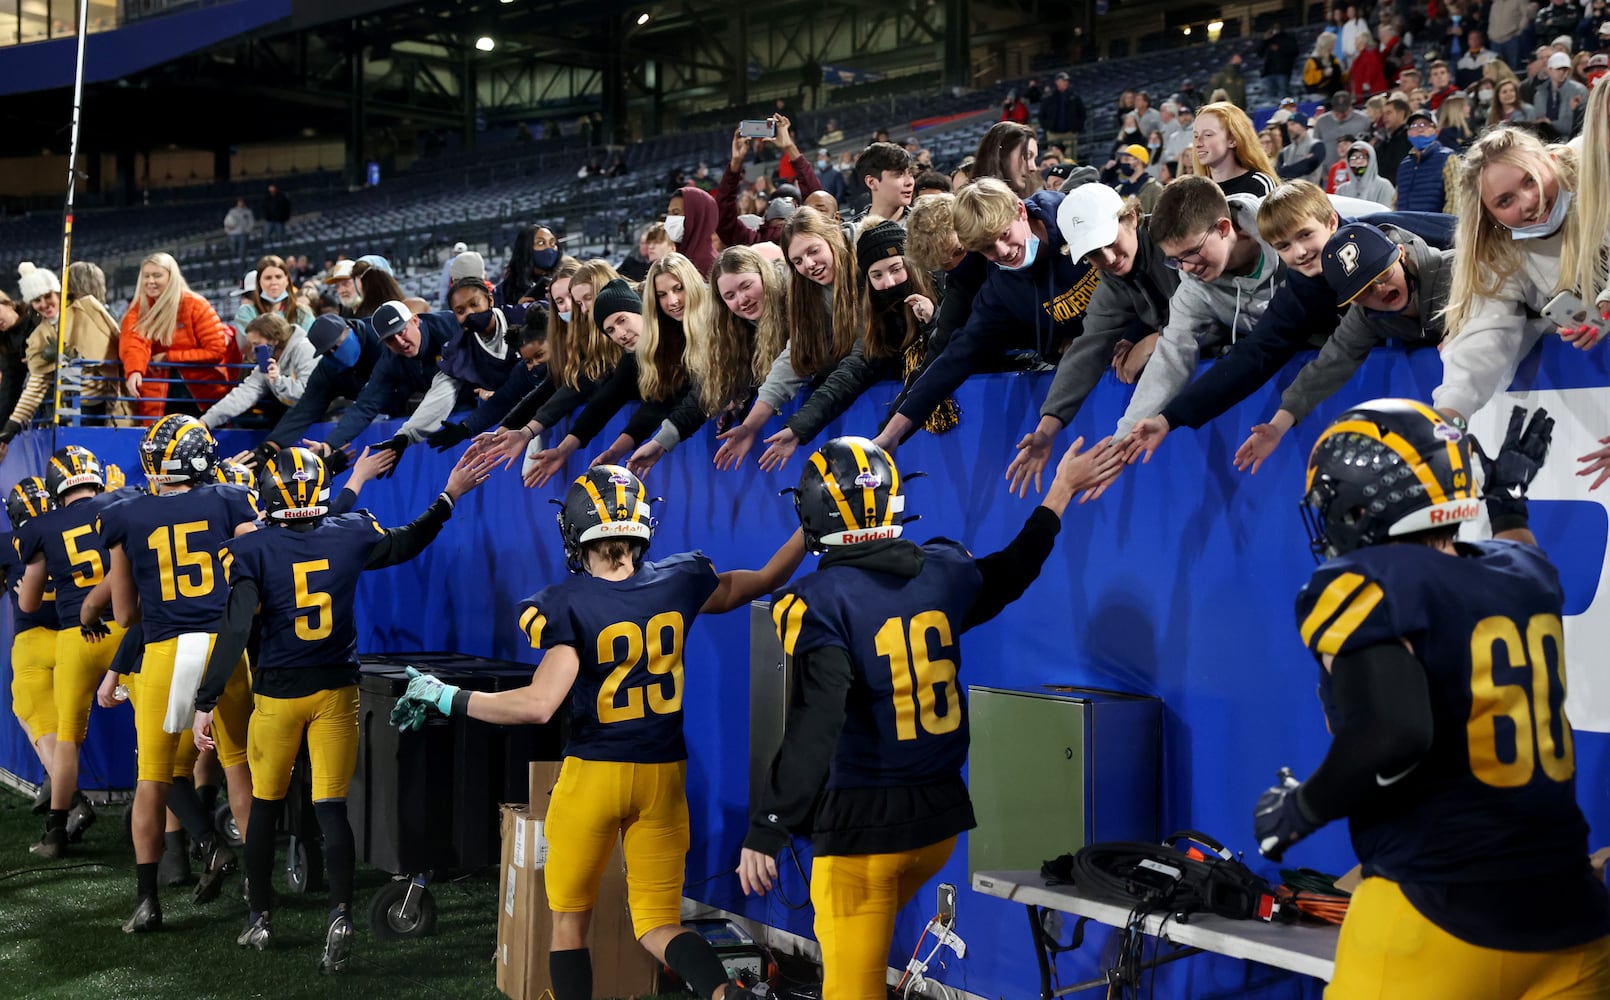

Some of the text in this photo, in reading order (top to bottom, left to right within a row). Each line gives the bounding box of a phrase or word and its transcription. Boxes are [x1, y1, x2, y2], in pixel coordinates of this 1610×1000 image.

[1336, 242, 1360, 277] P
[284, 508, 320, 519] Riddell
[616, 509, 628, 519] 29
[842, 528, 894, 544] Riddell
[147, 520, 216, 602] 15
[292, 559, 333, 641] 5
[596, 611, 684, 724] 29
[874, 610, 962, 741] 16
[1467, 613, 1574, 788] 60
